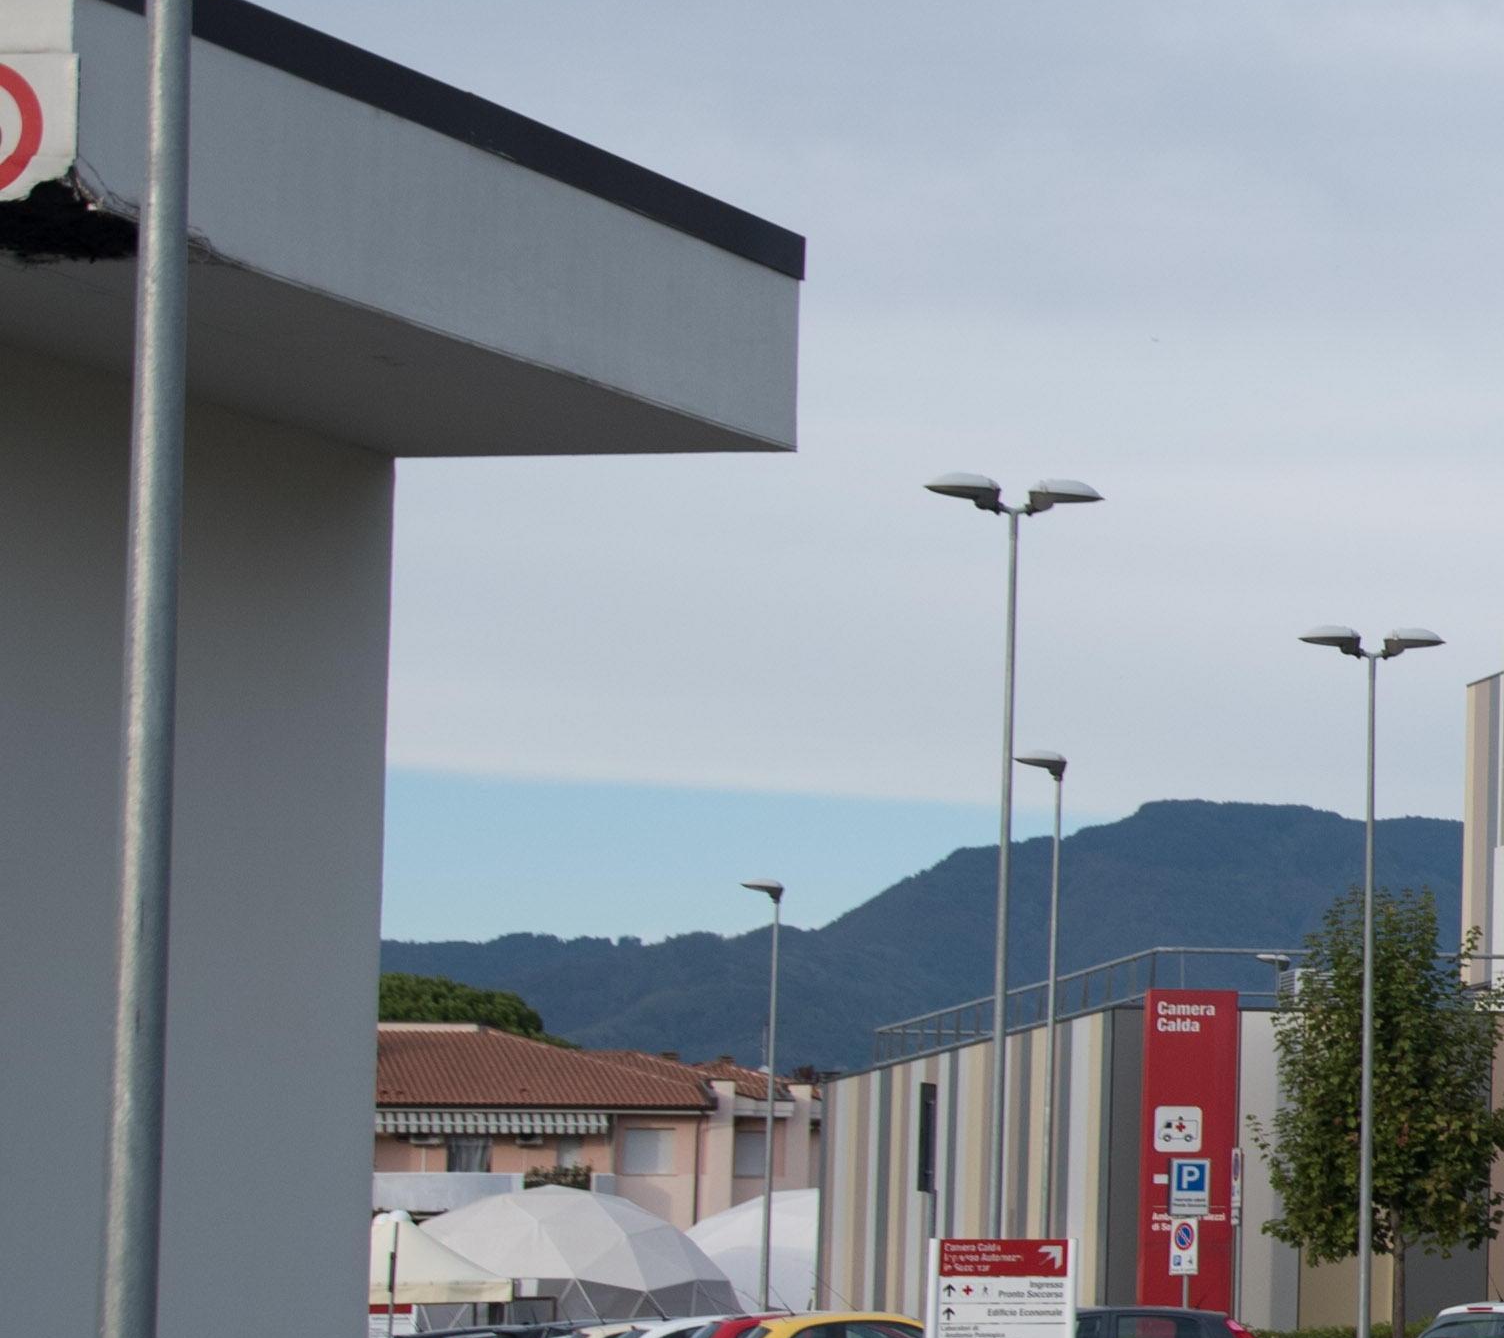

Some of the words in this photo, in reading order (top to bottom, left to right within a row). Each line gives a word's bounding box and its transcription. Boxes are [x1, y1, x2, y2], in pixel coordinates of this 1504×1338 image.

[1157, 1001, 1216, 1016] Camera
[1157, 1017, 1200, 1032] Calda
[998, 1290, 1025, 1298] Pronto
[1027, 1290, 1064, 1298] Soccorso
[987, 1308, 1017, 1316] Edificio
[1019, 1308, 1063, 1316] Economale
